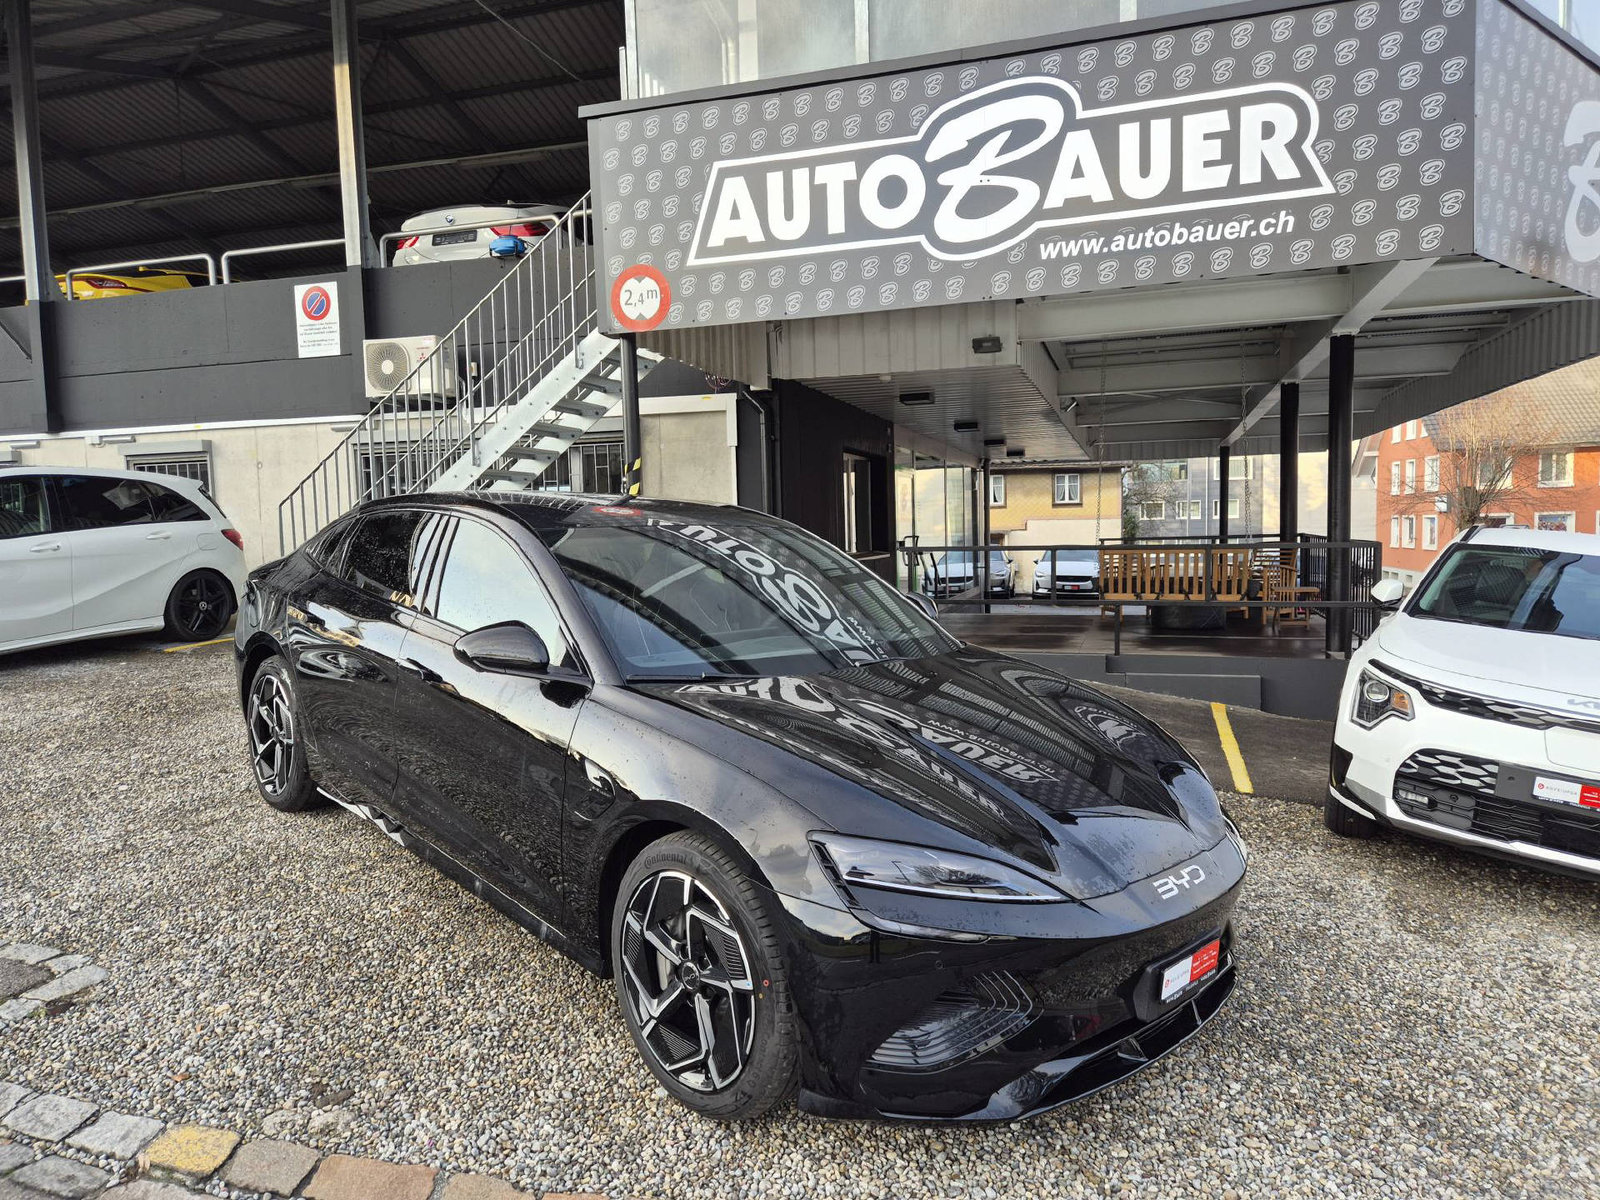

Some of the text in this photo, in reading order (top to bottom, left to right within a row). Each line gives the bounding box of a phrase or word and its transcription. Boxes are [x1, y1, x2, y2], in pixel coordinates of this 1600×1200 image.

[707, 93, 1302, 248] AUTO BAUER
[1039, 209, 1296, 260] www.autobauer.ch
[1153, 864, 1206, 900] BYD
